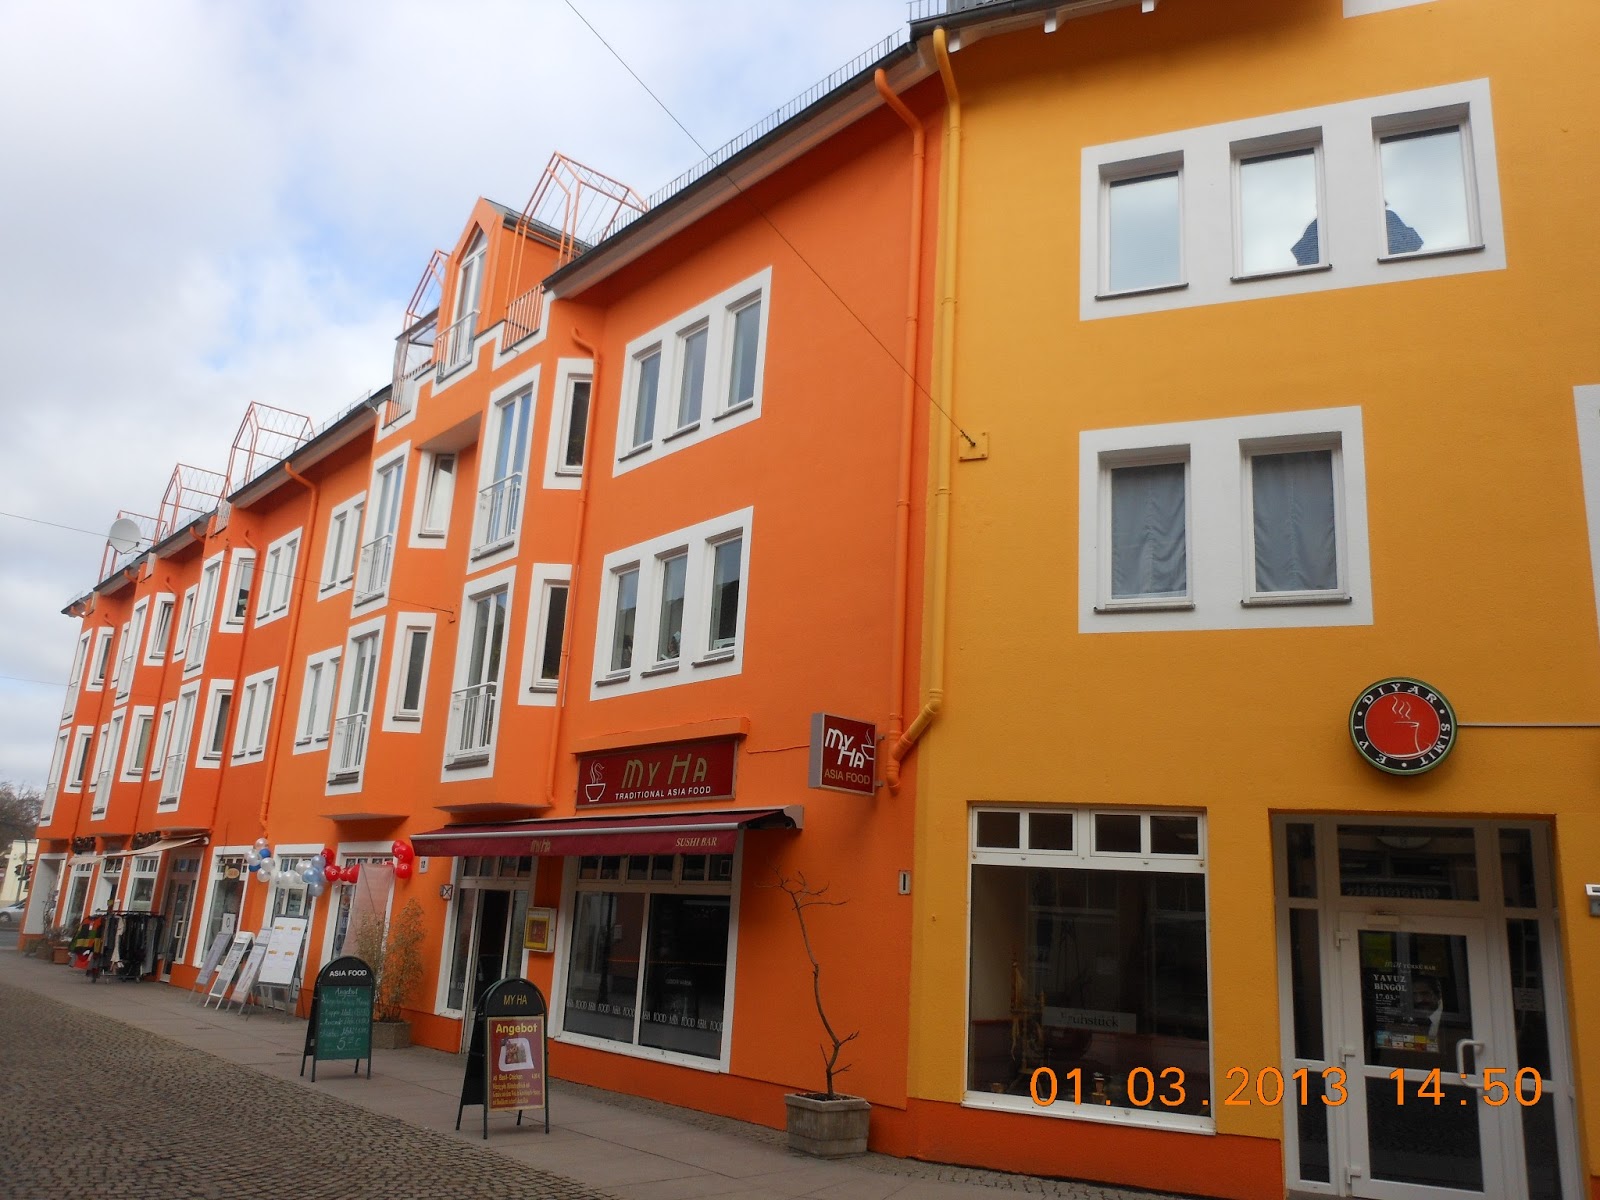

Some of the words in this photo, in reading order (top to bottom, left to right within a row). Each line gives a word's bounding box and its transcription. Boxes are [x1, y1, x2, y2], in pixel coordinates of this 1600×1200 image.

[1362, 683, 1437, 705] DIYAR
[824, 727, 855, 751] MY
[1354, 725, 1387, 765] EVI
[1420, 722, 1451, 766] SIMIT
[837, 746, 865, 768] HA
[621, 759, 661, 790] MY
[667, 753, 708, 785] HA
[824, 768, 844, 781] ASIA
[845, 772, 871, 785] FOOD
[615, 788, 665, 802] TRADITIONAL
[667, 787, 686, 797] ASIA
[688, 785, 711, 796] FOOD
[675, 837, 700, 848] SUSHI
[701, 837, 718, 847] BAR
[329, 970, 347, 978] ASIA
[348, 969, 368, 978] FOOD
[1373, 974, 1406, 983] YAVUZ
[503, 994, 516, 1006] MY
[516, 994, 528, 1006] HA
[495, 1022, 538, 1036] Angebot
